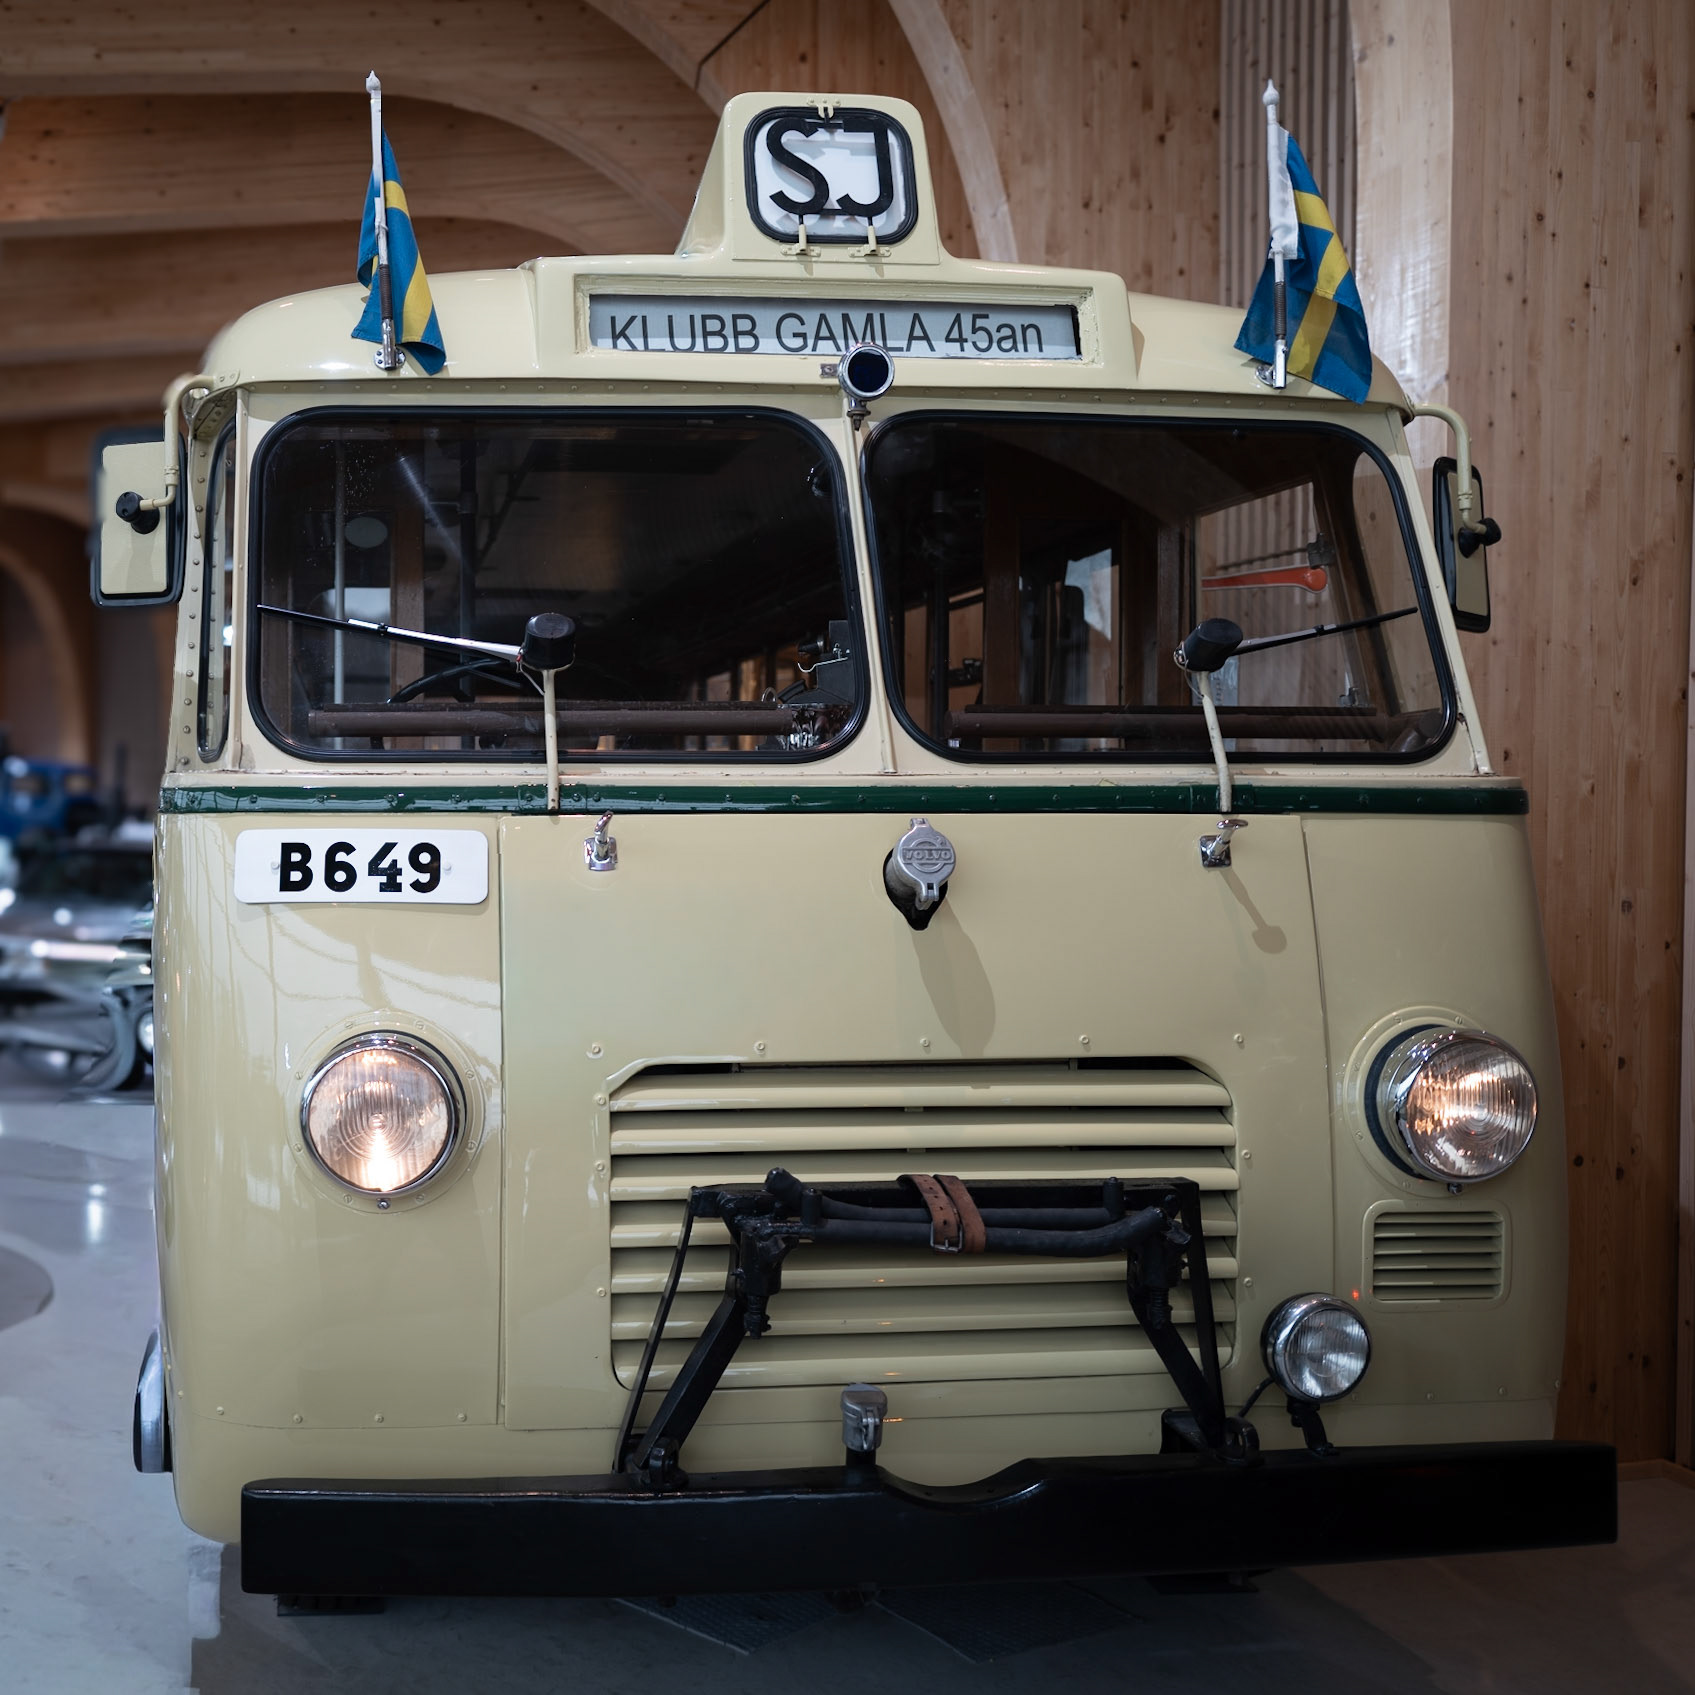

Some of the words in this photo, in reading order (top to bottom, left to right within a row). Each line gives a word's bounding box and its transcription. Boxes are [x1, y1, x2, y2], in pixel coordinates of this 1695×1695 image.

[766, 117, 894, 217] SJ
[610, 313, 760, 353] KLUBB
[775, 312, 937, 353] GAMLA
[944, 312, 1044, 353] 45an
[279, 841, 442, 893] B649
[903, 849, 952, 860] VOLVO
